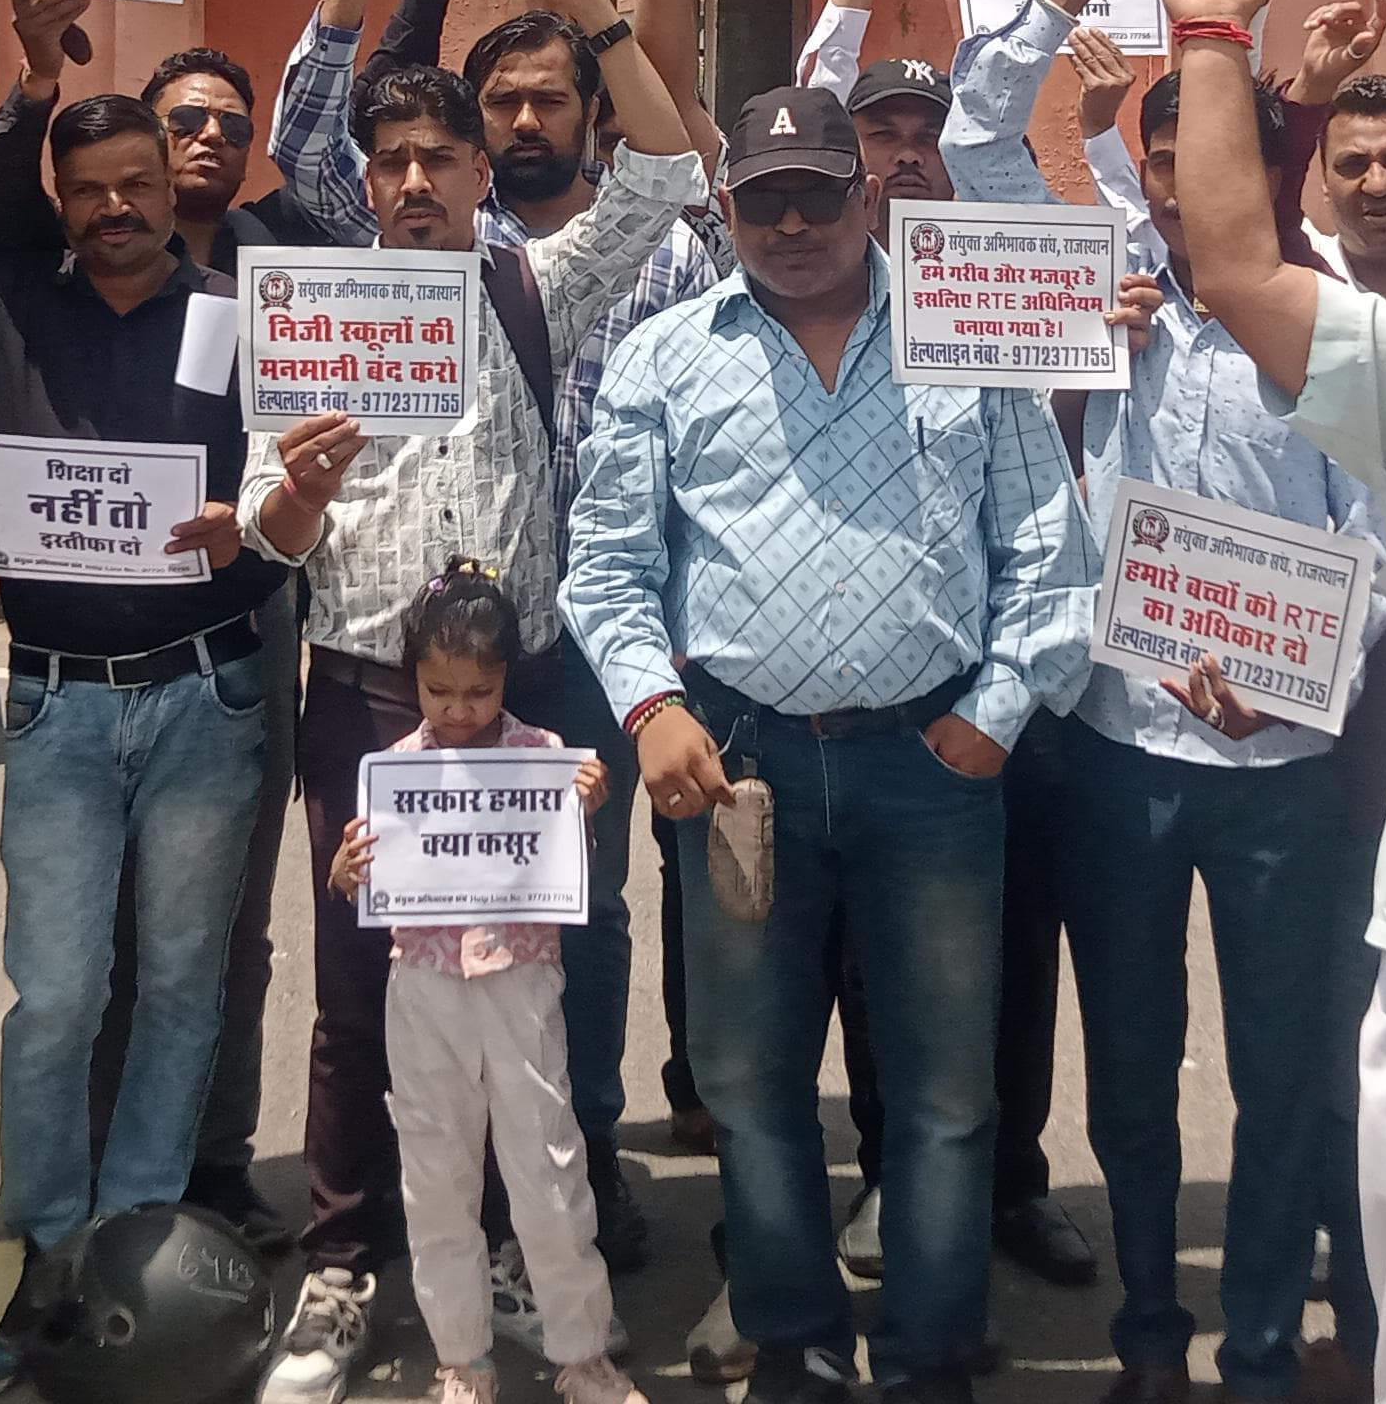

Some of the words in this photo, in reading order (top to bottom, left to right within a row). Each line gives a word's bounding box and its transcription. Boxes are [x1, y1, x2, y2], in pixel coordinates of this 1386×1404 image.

[902, 59, 935, 86] NY
[769, 107, 798, 136] A
[919, 265, 944, 280] हम
[993, 263, 1025, 283] और
[1079, 265, 1095, 285] है
[297, 277, 333, 303] संयुक्त
[334, 277, 390, 299] अभिभावक
[391, 279, 413, 303] संघ,
[415, 284, 461, 301] राजस्थान
[912, 288, 971, 309] इसलिए
[977, 291, 1016, 309] RTE
[1021, 291, 1103, 312] अधिनियम
[268, 313, 333, 342] निजी
[339, 315, 413, 351] स्कूलों
[419, 316, 454, 344] की
[1007, 321, 1040, 337] गया
[908, 335, 970, 366] हेल्पलाइन
[1012, 345, 1109, 366] 9772377755
[257, 353, 359, 381] मनमानी
[365, 353, 403, 382] बंद
[408, 355, 457, 383] करो
[256, 384, 317, 413] हेल्पलाइन
[320, 384, 348, 411] नंबर
[361, 391, 459, 413] 9772377755
[46, 458, 104, 482] शिक्षा
[107, 462, 132, 484] दो
[26, 488, 103, 526] नहीं
[106, 491, 152, 530] तो
[38, 531, 115, 553] इस्तीफा
[118, 535, 142, 556] दो
[1124, 558, 1179, 593] हमारे
[1185, 575, 1240, 611] बच्चों
[1244, 591, 1277, 622] को
[1283, 602, 1339, 639] RTE
[1143, 596, 1174, 626] का
[1179, 608, 1276, 656] अधिकार
[1282, 634, 1308, 665] दो
[1111, 616, 1177, 660] हेल्पलाइन
[1219, 655, 1327, 703] 9772377755
[392, 788, 483, 813] सरकार
[487, 787, 564, 812] हमारा
[420, 832, 472, 857] क्या
[475, 831, 541, 865] कसूर
